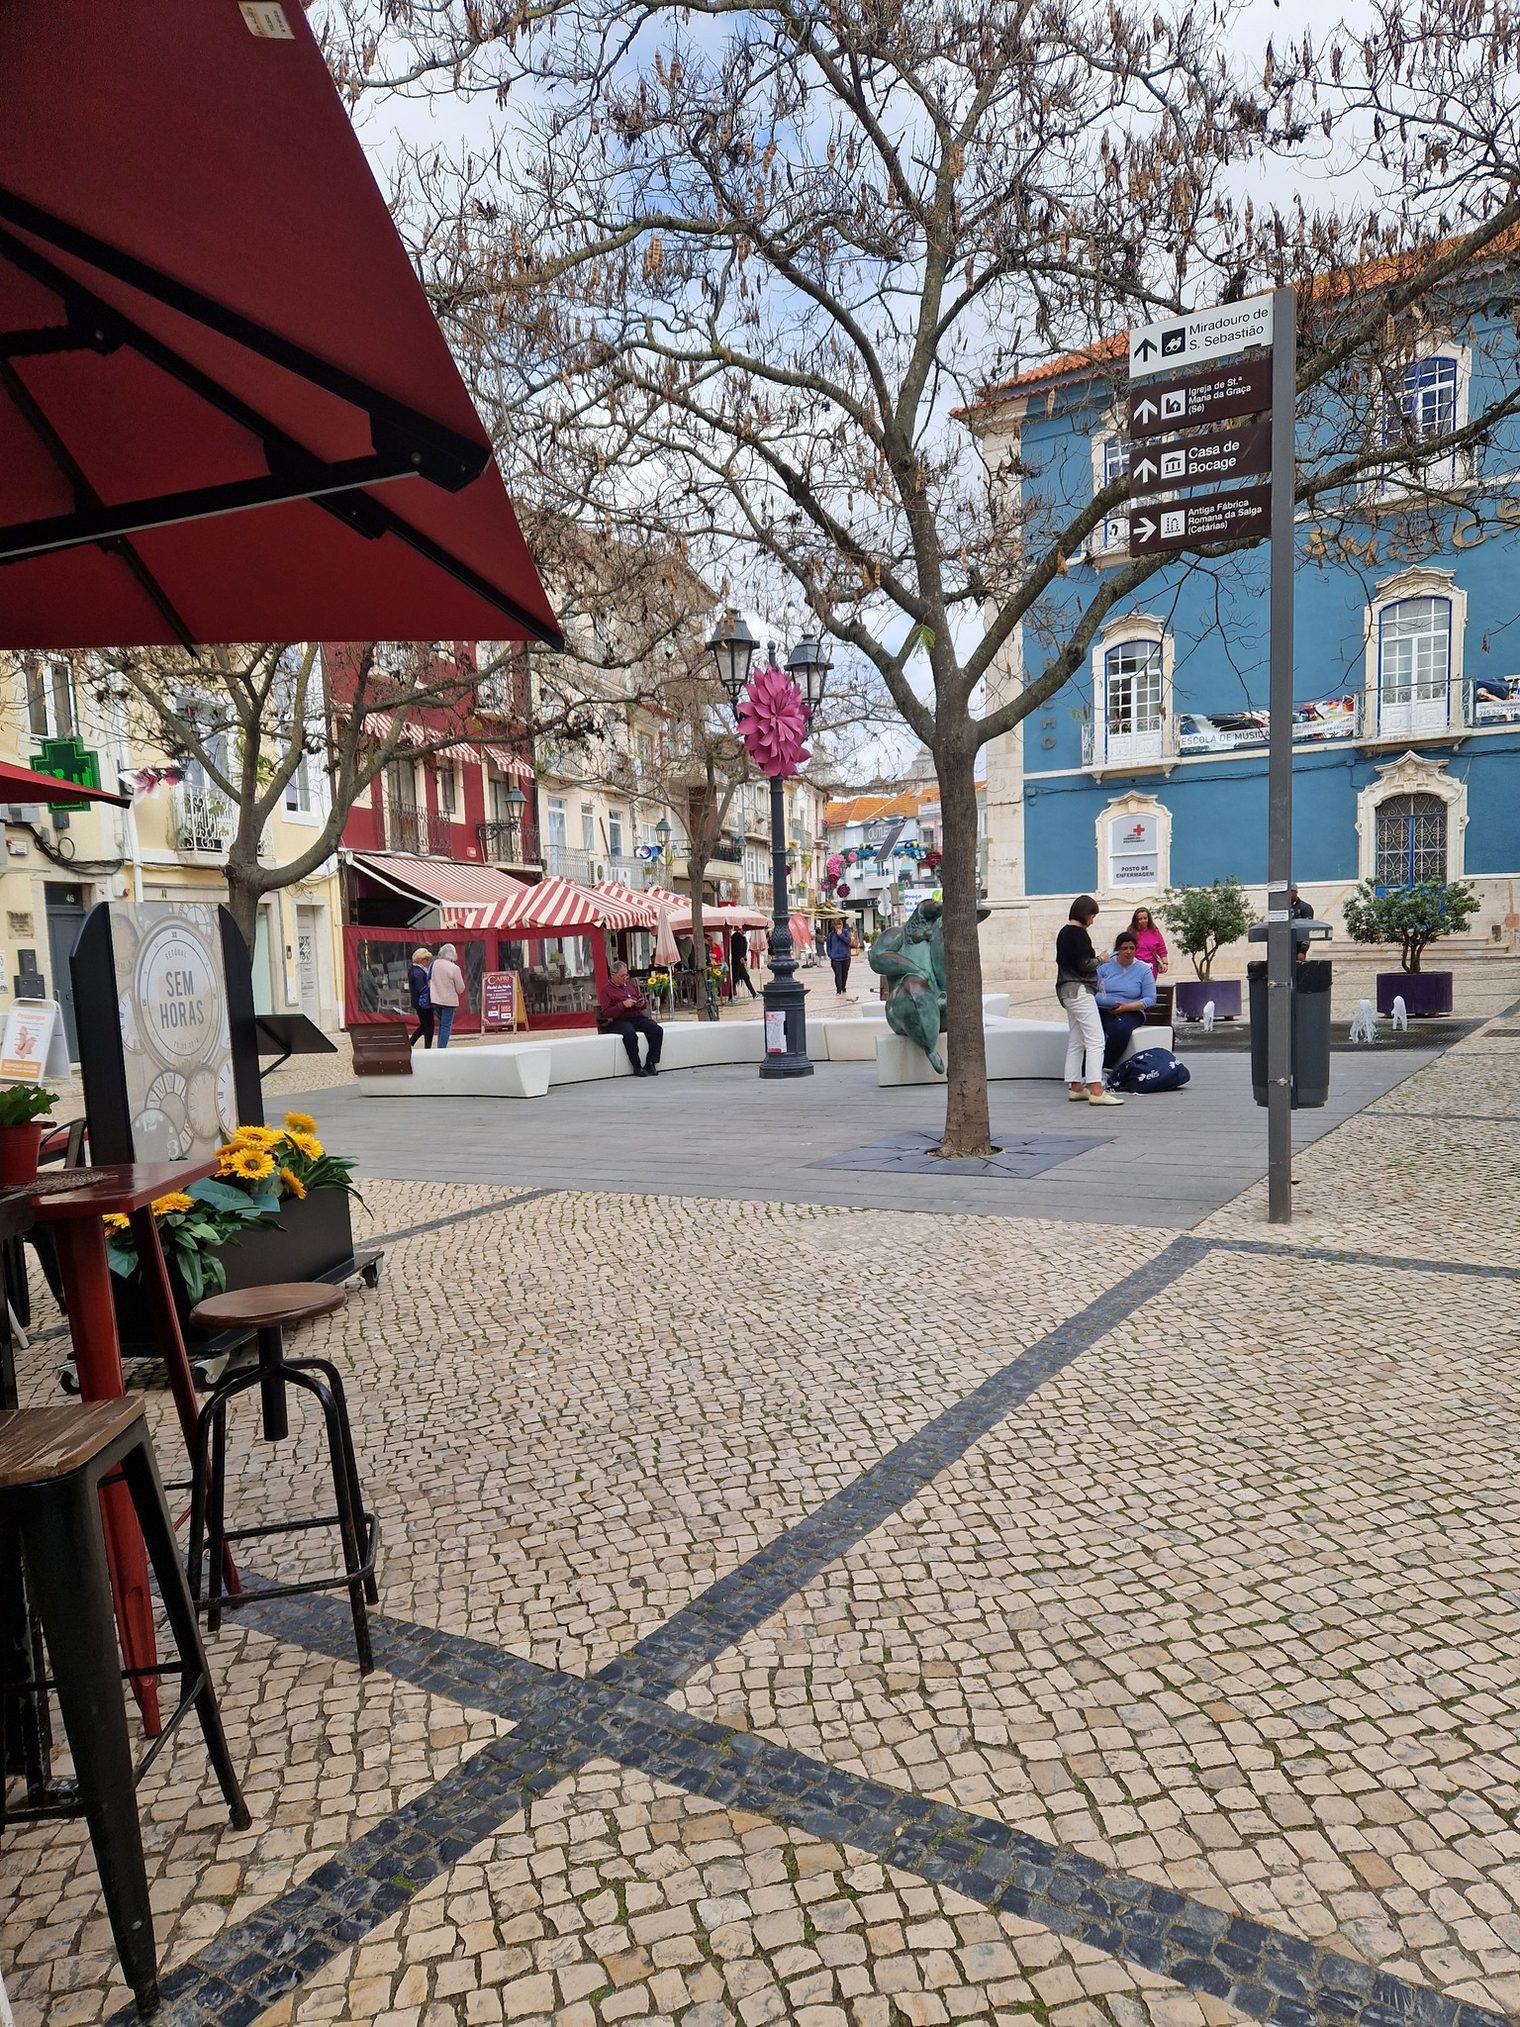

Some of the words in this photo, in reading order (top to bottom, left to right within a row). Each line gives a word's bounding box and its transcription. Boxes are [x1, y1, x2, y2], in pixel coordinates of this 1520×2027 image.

[1189, 313, 1250, 336] Miradouro
[1253, 308, 1269, 319] de
[1189, 339, 1200, 351] S.
[1204, 325, 1264, 347] Sebastião
[1188, 384, 1212, 397] Igreja
[1214, 381, 1225, 389] de
[1188, 393, 1212, 405] Maria
[1213, 390, 1225, 399] da
[1226, 385, 1252, 396] Graça
[1188, 403, 1205, 415] (Sé)
[1188, 445, 1221, 459] Casa
[1223, 440, 1240, 452] de
[1188, 457, 1237, 475] Bocage
[1187, 506, 1215, 517] Antiga
[1217, 499, 1249, 511] Fábrica
[1188, 513, 1223, 525] Romana
[1224, 510, 1236, 519] da
[1237, 506, 1263, 517] Salga
[1188, 520, 1228, 535] (Cetárias)
[1181, 735, 1218, 746] ESCOLA
[1219, 732, 1232, 743] DE
[868, 825, 891, 840] OUTLE
[165, 970, 194, 997] SEM
[159, 999, 205, 1029] HORAS
